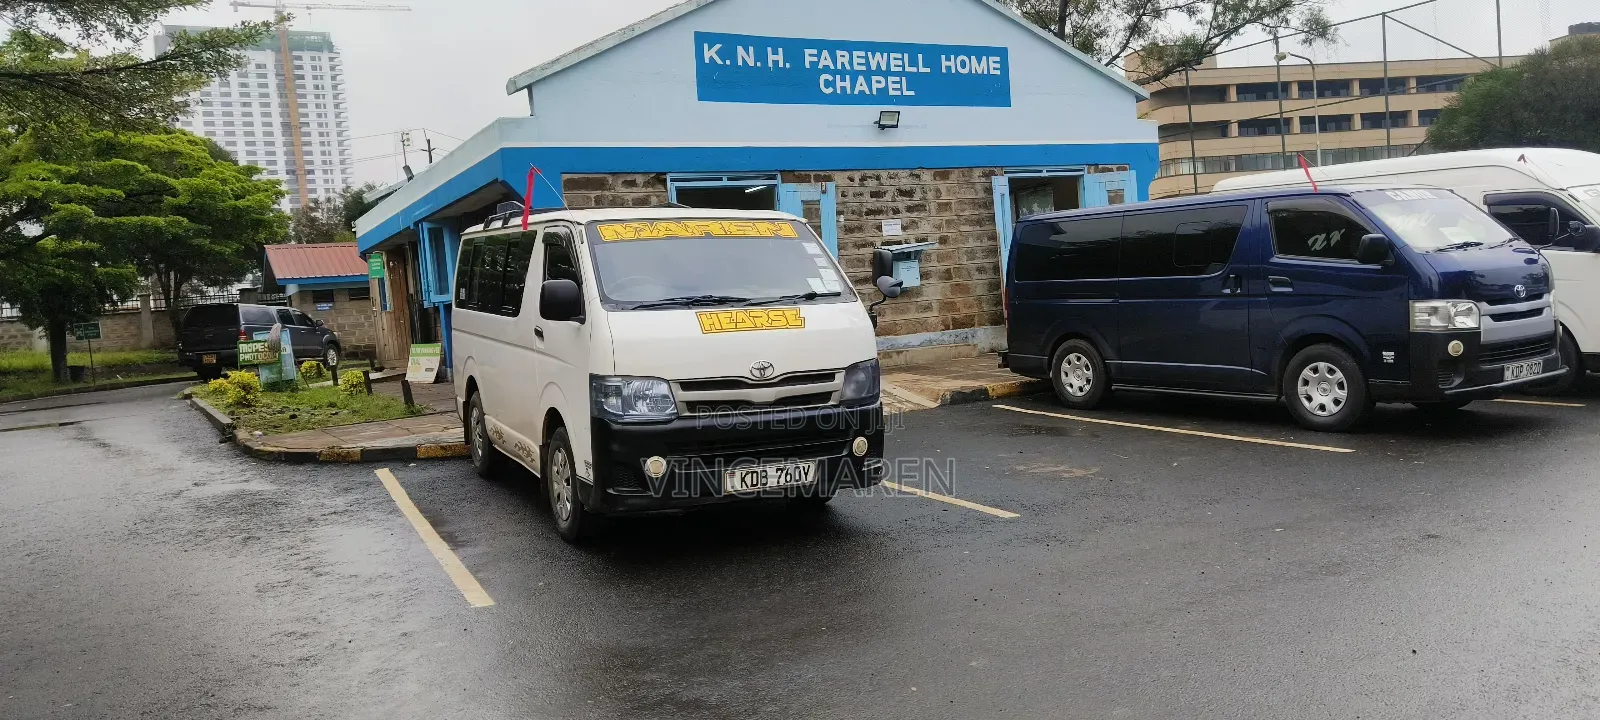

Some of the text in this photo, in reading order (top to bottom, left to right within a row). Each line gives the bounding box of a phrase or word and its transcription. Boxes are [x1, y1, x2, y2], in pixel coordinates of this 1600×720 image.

[804, 49, 931, 73] FAREWELL
[941, 54, 1001, 75] HOME
[819, 74, 916, 96] CHAPEL
[597, 220, 798, 242] MAREN
[696, 307, 805, 334] HEARSE
[740, 464, 811, 489] KDB 760Y
